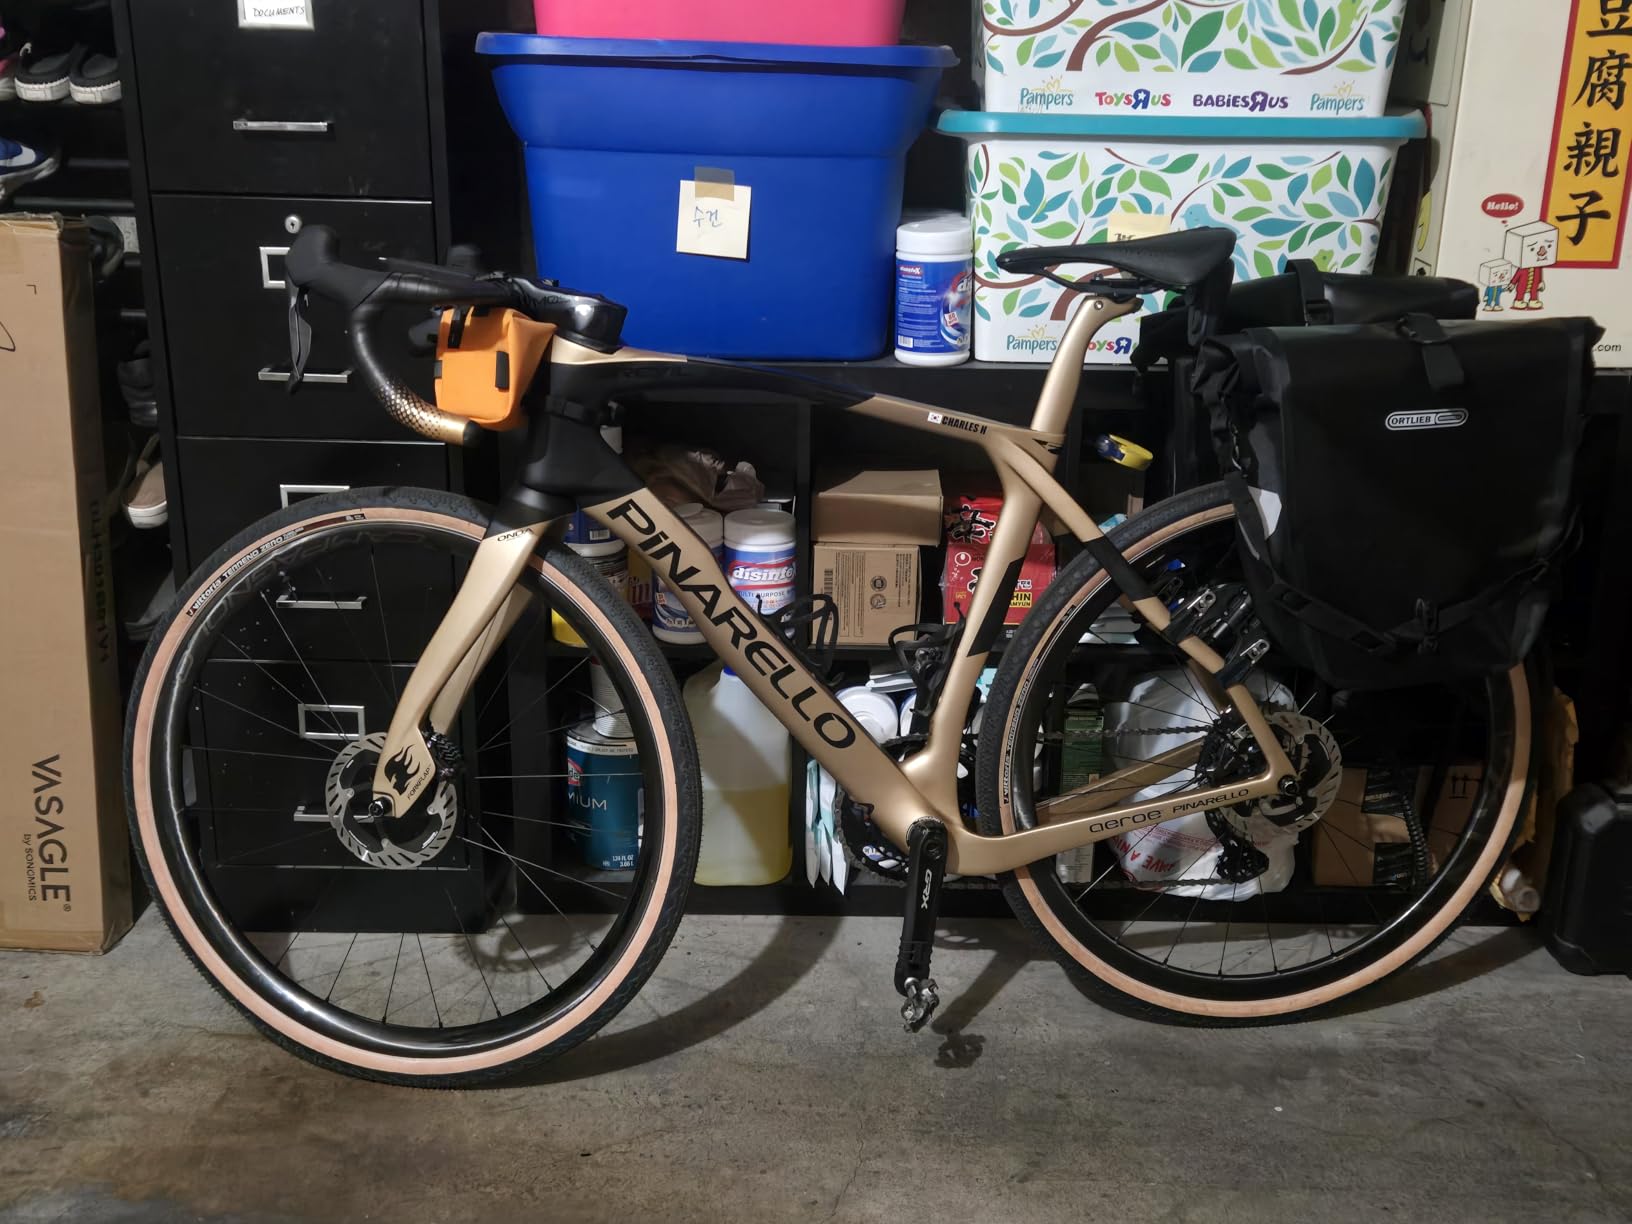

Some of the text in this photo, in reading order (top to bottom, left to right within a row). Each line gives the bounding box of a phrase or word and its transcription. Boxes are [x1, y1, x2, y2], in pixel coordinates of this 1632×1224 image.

[253, 6, 305, 17] DOCUMENTS
[1020, 88, 1073, 109] Pampers
[1310, 93, 1365, 115] Pampers
[1486, 201, 1519, 212] Hello!
[1006, 335, 1058, 354] Pampers
[941, 415, 988, 435] CHARLES H
[1391, 415, 1432, 425] ORTLIEB
[222, 549, 260, 579] TERRENO
[260, 536, 283, 552] ZERO
[732, 565, 796, 581] disinfe
[1012, 592, 1031, 600] HIN
[607, 498, 856, 749] PINARELLO
[1089, 789, 1249, 833] aeroe PINARELLO
[31, 754, 71, 902] VASAGLE
[921, 869, 932, 910] GRX
